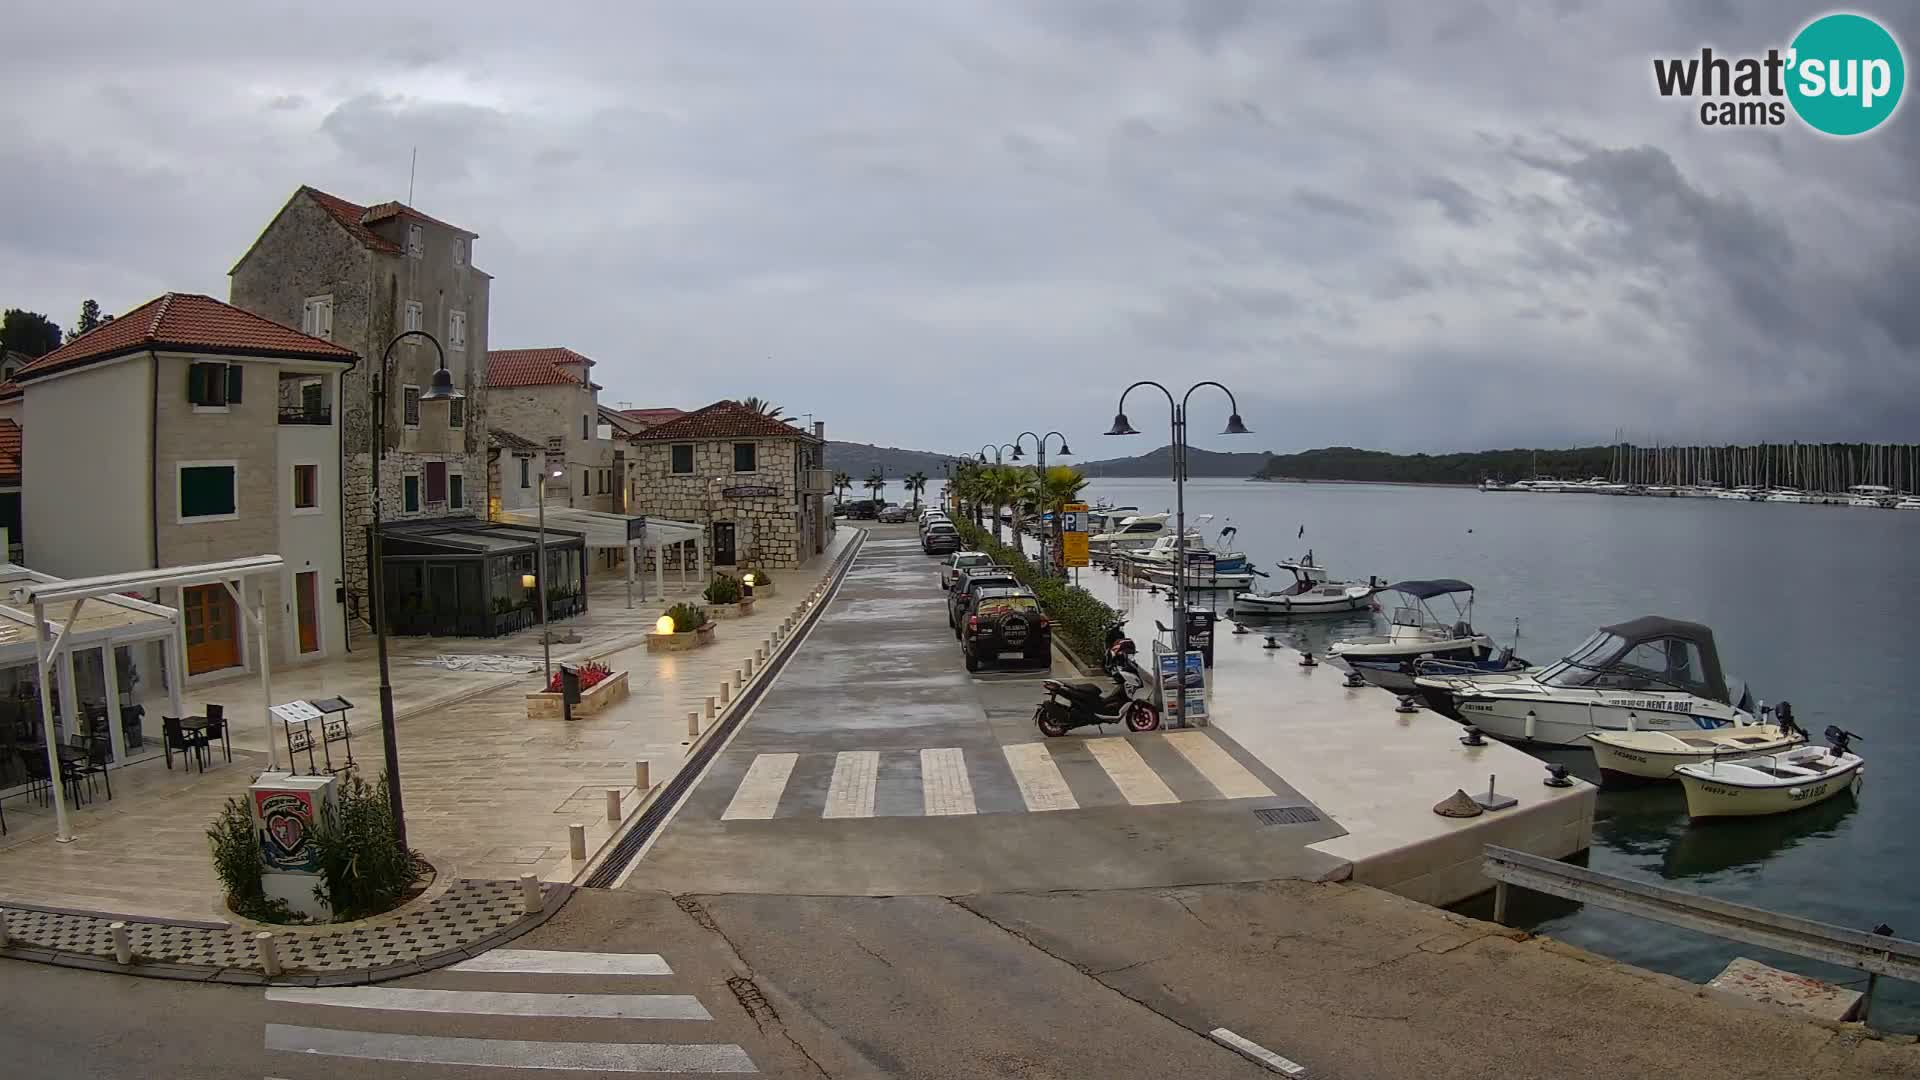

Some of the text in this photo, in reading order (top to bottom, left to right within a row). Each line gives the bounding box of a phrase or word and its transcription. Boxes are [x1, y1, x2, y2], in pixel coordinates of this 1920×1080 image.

[1065, 514, 1075, 530] P
[1646, 700, 1666, 710] RENT
[1667, 701, 1673, 711] A
[1673, 702, 1693, 713] BOAT
